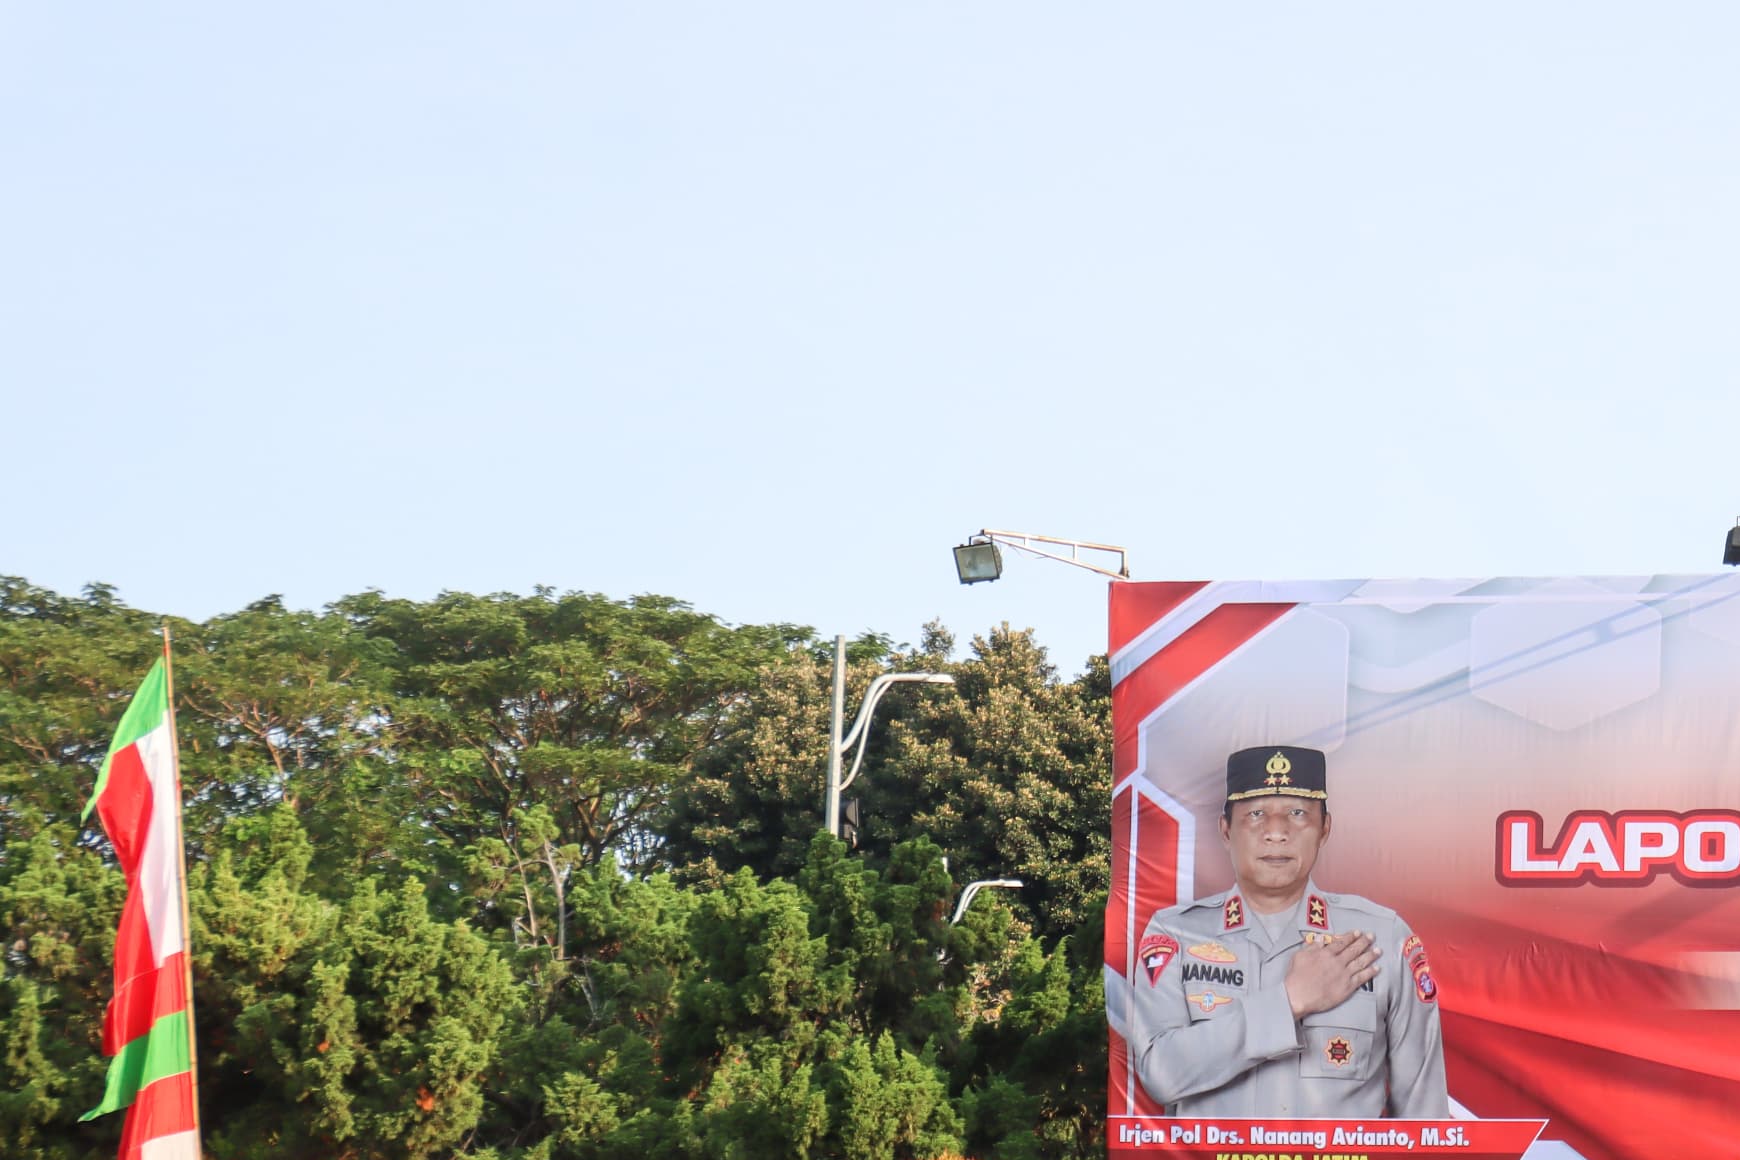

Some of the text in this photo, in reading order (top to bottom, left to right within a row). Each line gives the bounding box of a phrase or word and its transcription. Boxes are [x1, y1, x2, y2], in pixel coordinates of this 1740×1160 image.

[1182, 963, 1245, 987] NANANG
[1119, 1124, 1471, 1150] Irjen Pol Drs. Nanang Avianto, M.Si.
